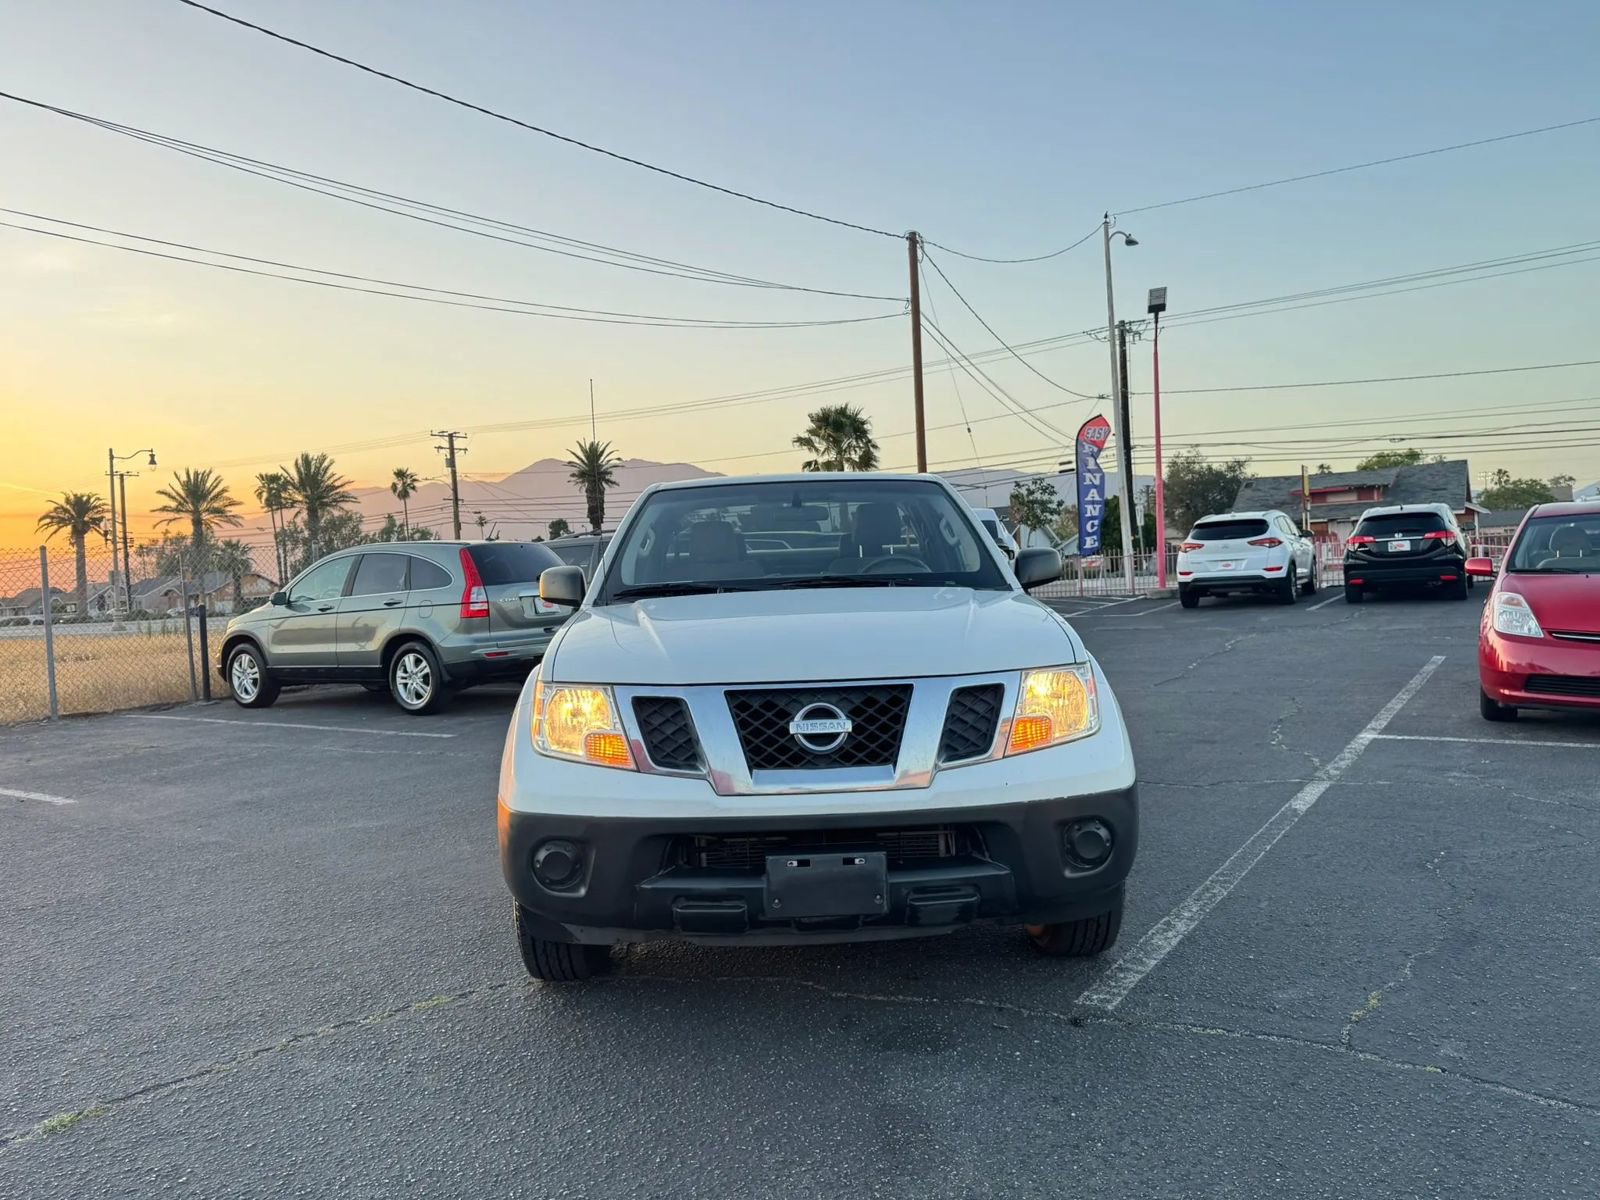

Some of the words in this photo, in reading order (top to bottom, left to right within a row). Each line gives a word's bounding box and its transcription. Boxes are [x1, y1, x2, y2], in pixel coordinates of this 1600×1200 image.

[1085, 426, 1109, 440] EASY
[1082, 442, 1103, 549] FINANCE
[795, 721, 847, 732] NISSAN
